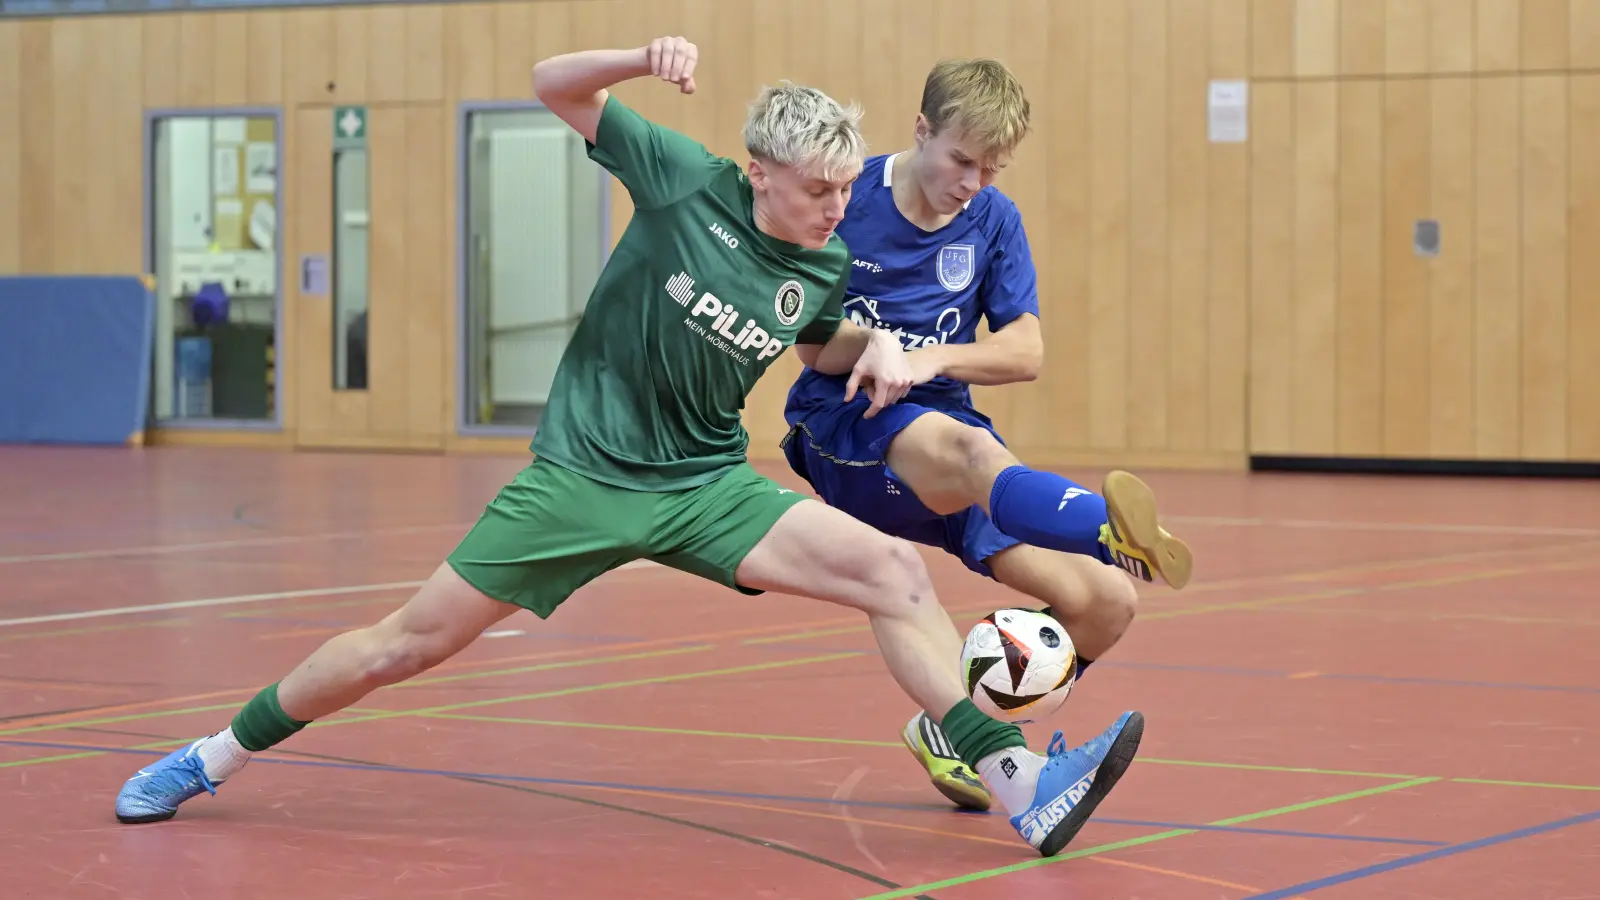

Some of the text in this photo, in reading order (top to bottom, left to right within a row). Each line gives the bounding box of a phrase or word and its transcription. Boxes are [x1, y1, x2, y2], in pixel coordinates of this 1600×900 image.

[709, 223, 739, 249] JAKO
[852, 259, 873, 270] AFT
[683, 317, 707, 337] MEIN
[1037, 796, 1072, 831] JUST
